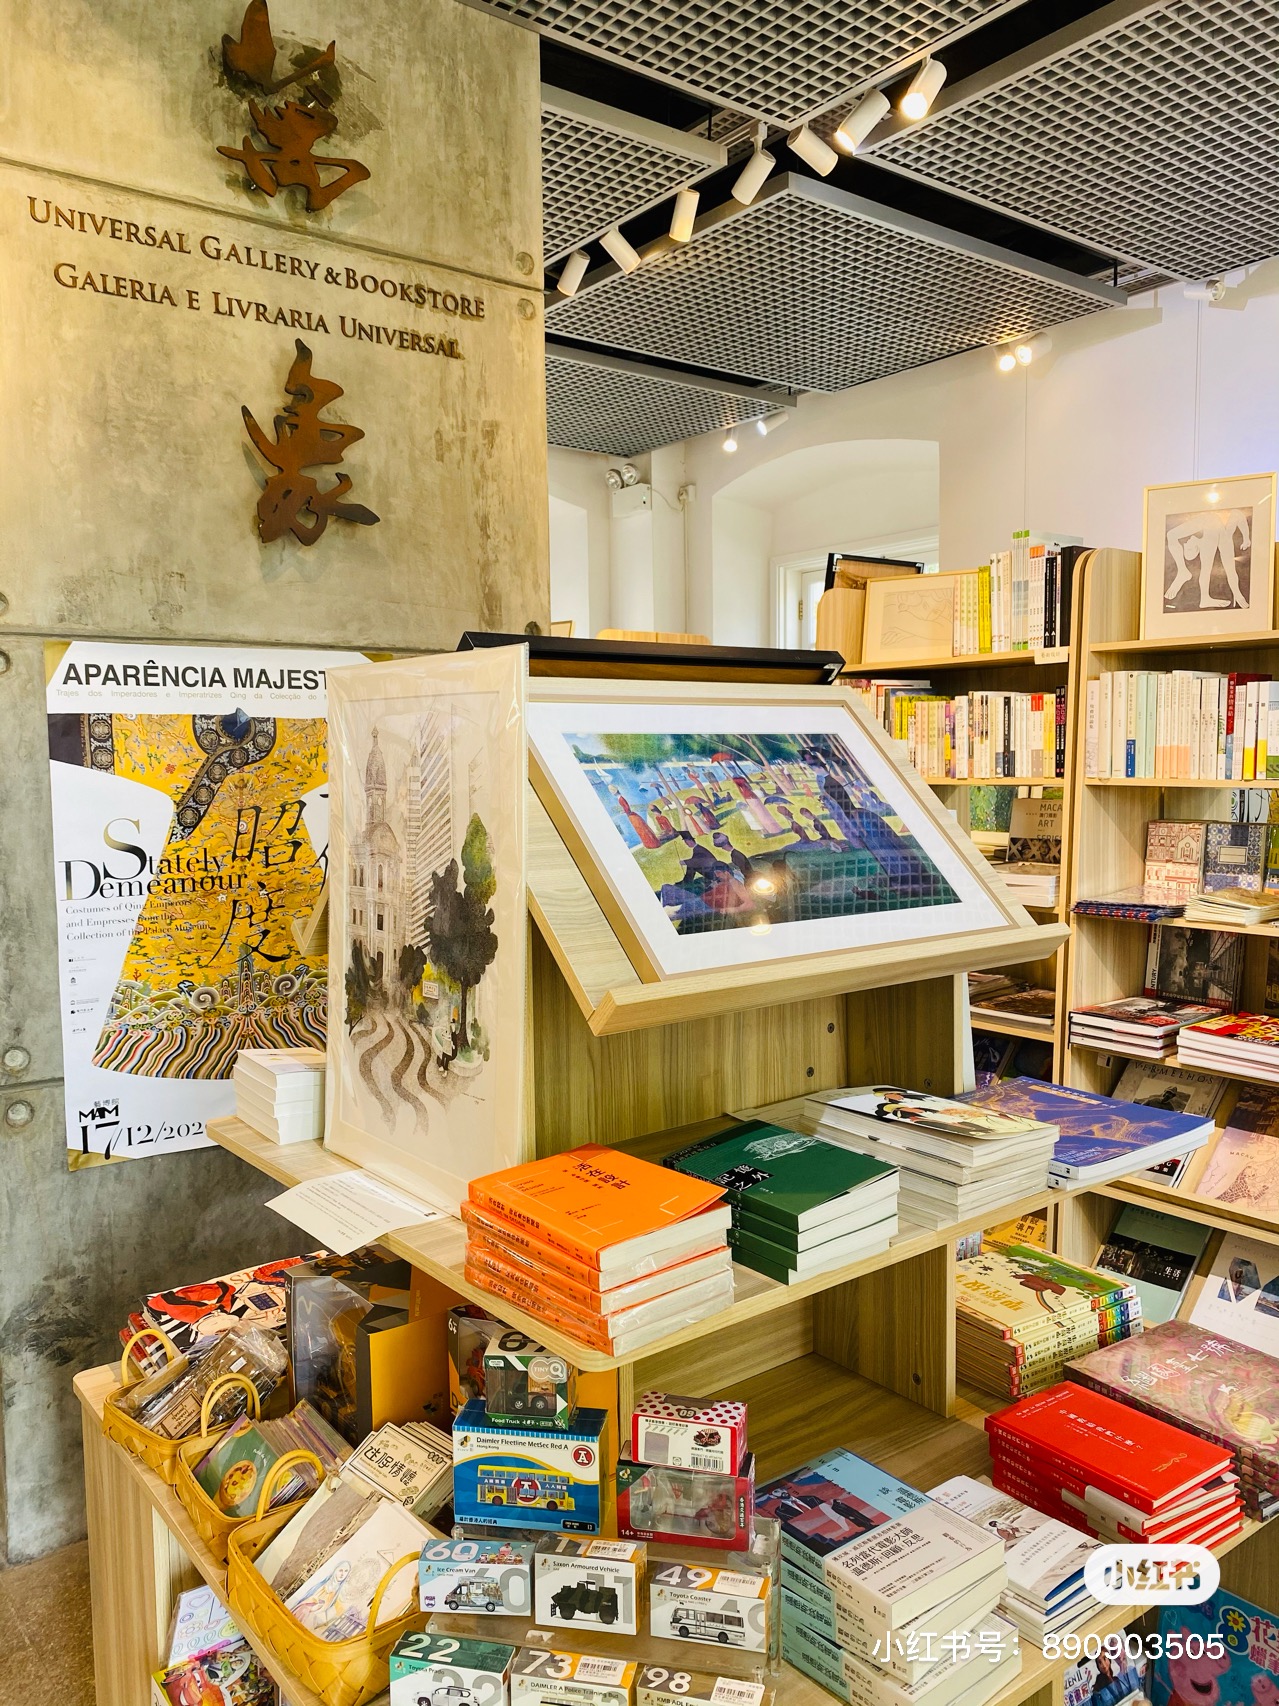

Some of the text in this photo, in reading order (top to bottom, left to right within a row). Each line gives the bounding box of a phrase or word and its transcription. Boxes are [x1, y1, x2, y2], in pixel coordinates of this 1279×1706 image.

[27, 195, 191, 254] UNIVERSAL
[199, 234, 321, 281] GALLERY
[53, 261, 465, 360] GALERIA E LIVRARIA UNIVERSAL
[62, 659, 227, 688] APARÊNCIA
[56, 689, 80, 698] Trajes
[87, 689, 103, 697] dos
[111, 689, 158, 698] Imperadores
[178, 691, 223, 699] Imperatrizes
[229, 691, 247, 701] Qing
[254, 692, 263, 700] da
[270, 692, 301, 701] Colecção
[1037, 819, 1055, 828] ART
[102, 817, 221, 881] Stately
[58, 859, 248, 901] Demeanour
[65, 899, 193, 914] Costumes of Qing Emperors
[65, 911, 177, 928] and Empresses from the
[66, 929, 114, 941] Collection
[116, 928, 126, 938] of
[144, 924, 172, 935] Palace
[174, 922, 212, 933] Museum
[78, 1105, 119, 1123] MAM
[81, 1120, 206, 1161] 17/12/202
[575, 1162, 631, 1190] 活在設計
[1164, 1266, 1181, 1278] 生活
[577, 1450, 589, 1464] A
[425, 1541, 479, 1561] 60
[841, 1526, 914, 1569] 名列當代電影大師
[552, 1560, 570, 1568] Saxon
[570, 1562, 599, 1571] Armoured
[655, 1565, 713, 1588] 49
[669, 1591, 712, 1602] Toyota Coaster
[398, 1633, 461, 1663] 22
[408, 1664, 445, 1675] Toyota Prado
[521, 1650, 573, 1679] 73
[530, 1682, 558, 1690] DAIMLER
[564, 1686, 581, 1694] Police
[583, 1688, 607, 1698] Training
[646, 1667, 692, 1694] 98
